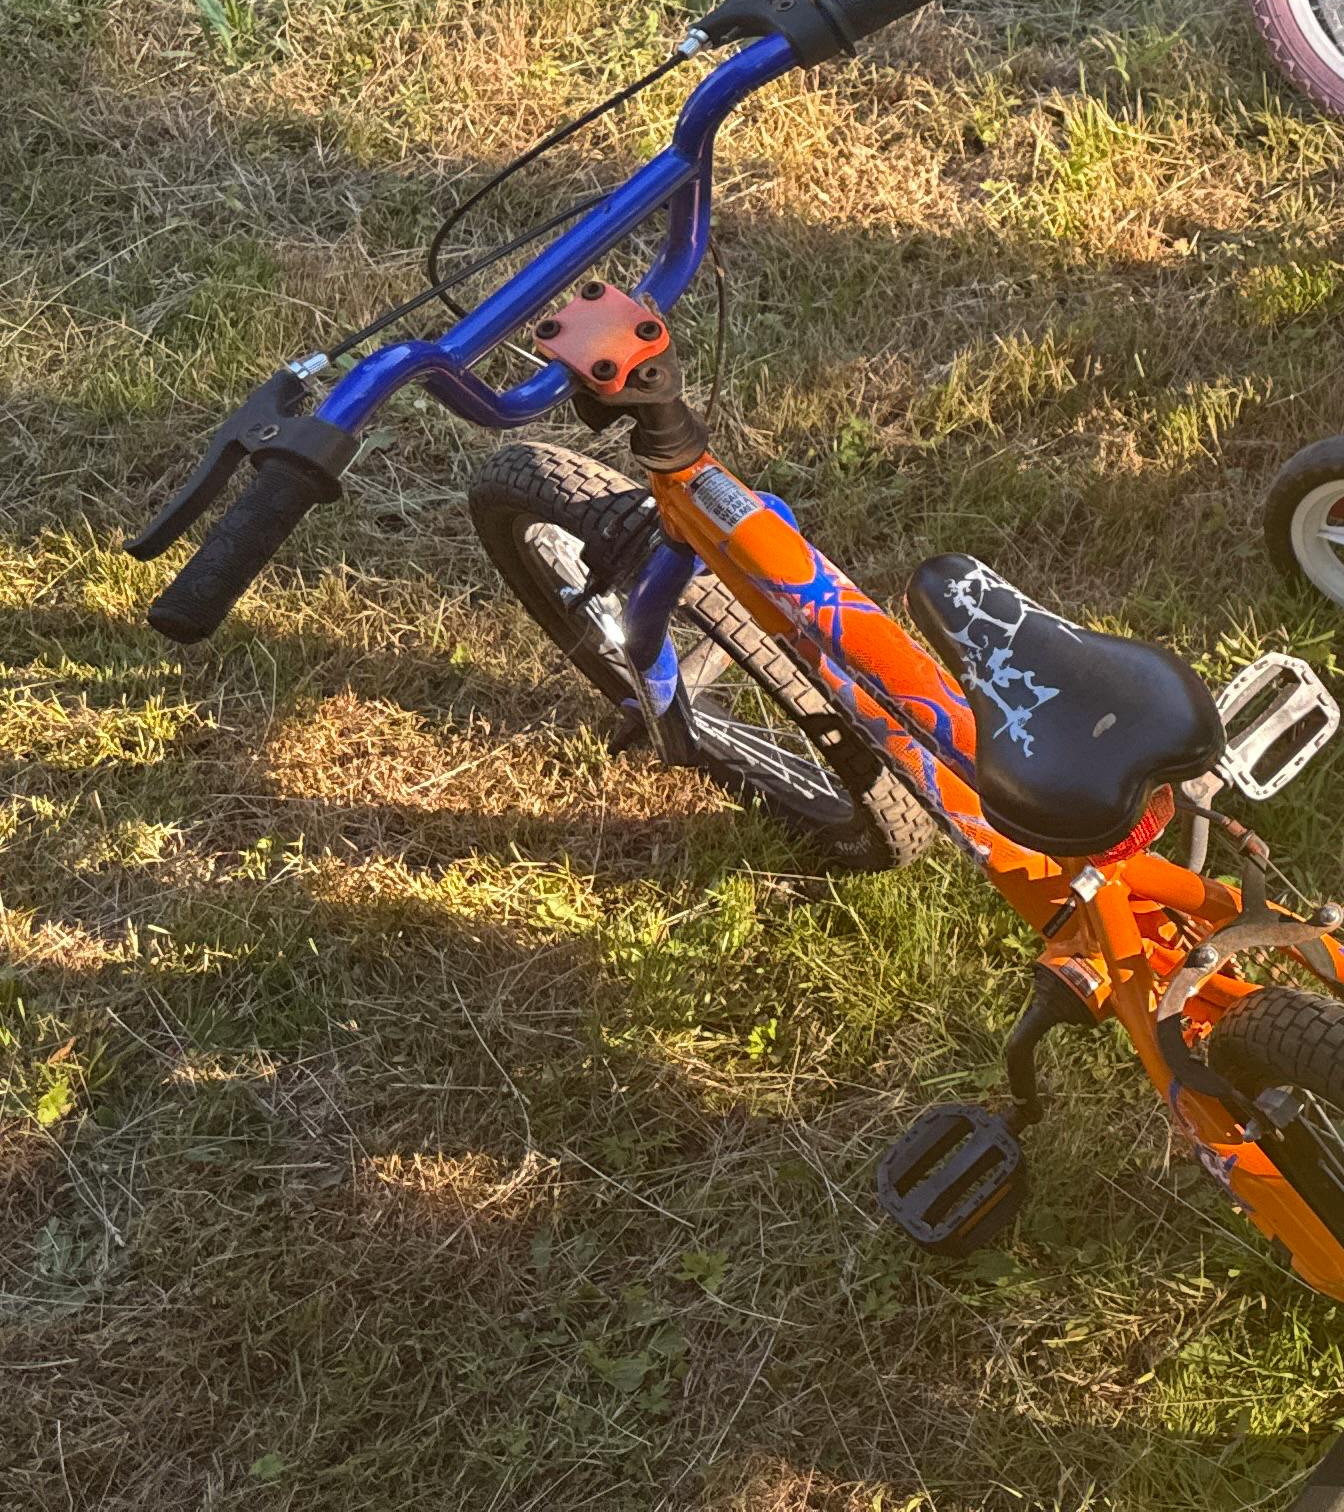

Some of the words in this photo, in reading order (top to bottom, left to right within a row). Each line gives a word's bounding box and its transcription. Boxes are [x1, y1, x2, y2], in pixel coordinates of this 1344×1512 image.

[713, 503, 725, 515] BE
[722, 489, 743, 505] SAFE
[719, 499, 744, 521] WEAR
[726, 501, 757, 527] HELMET
